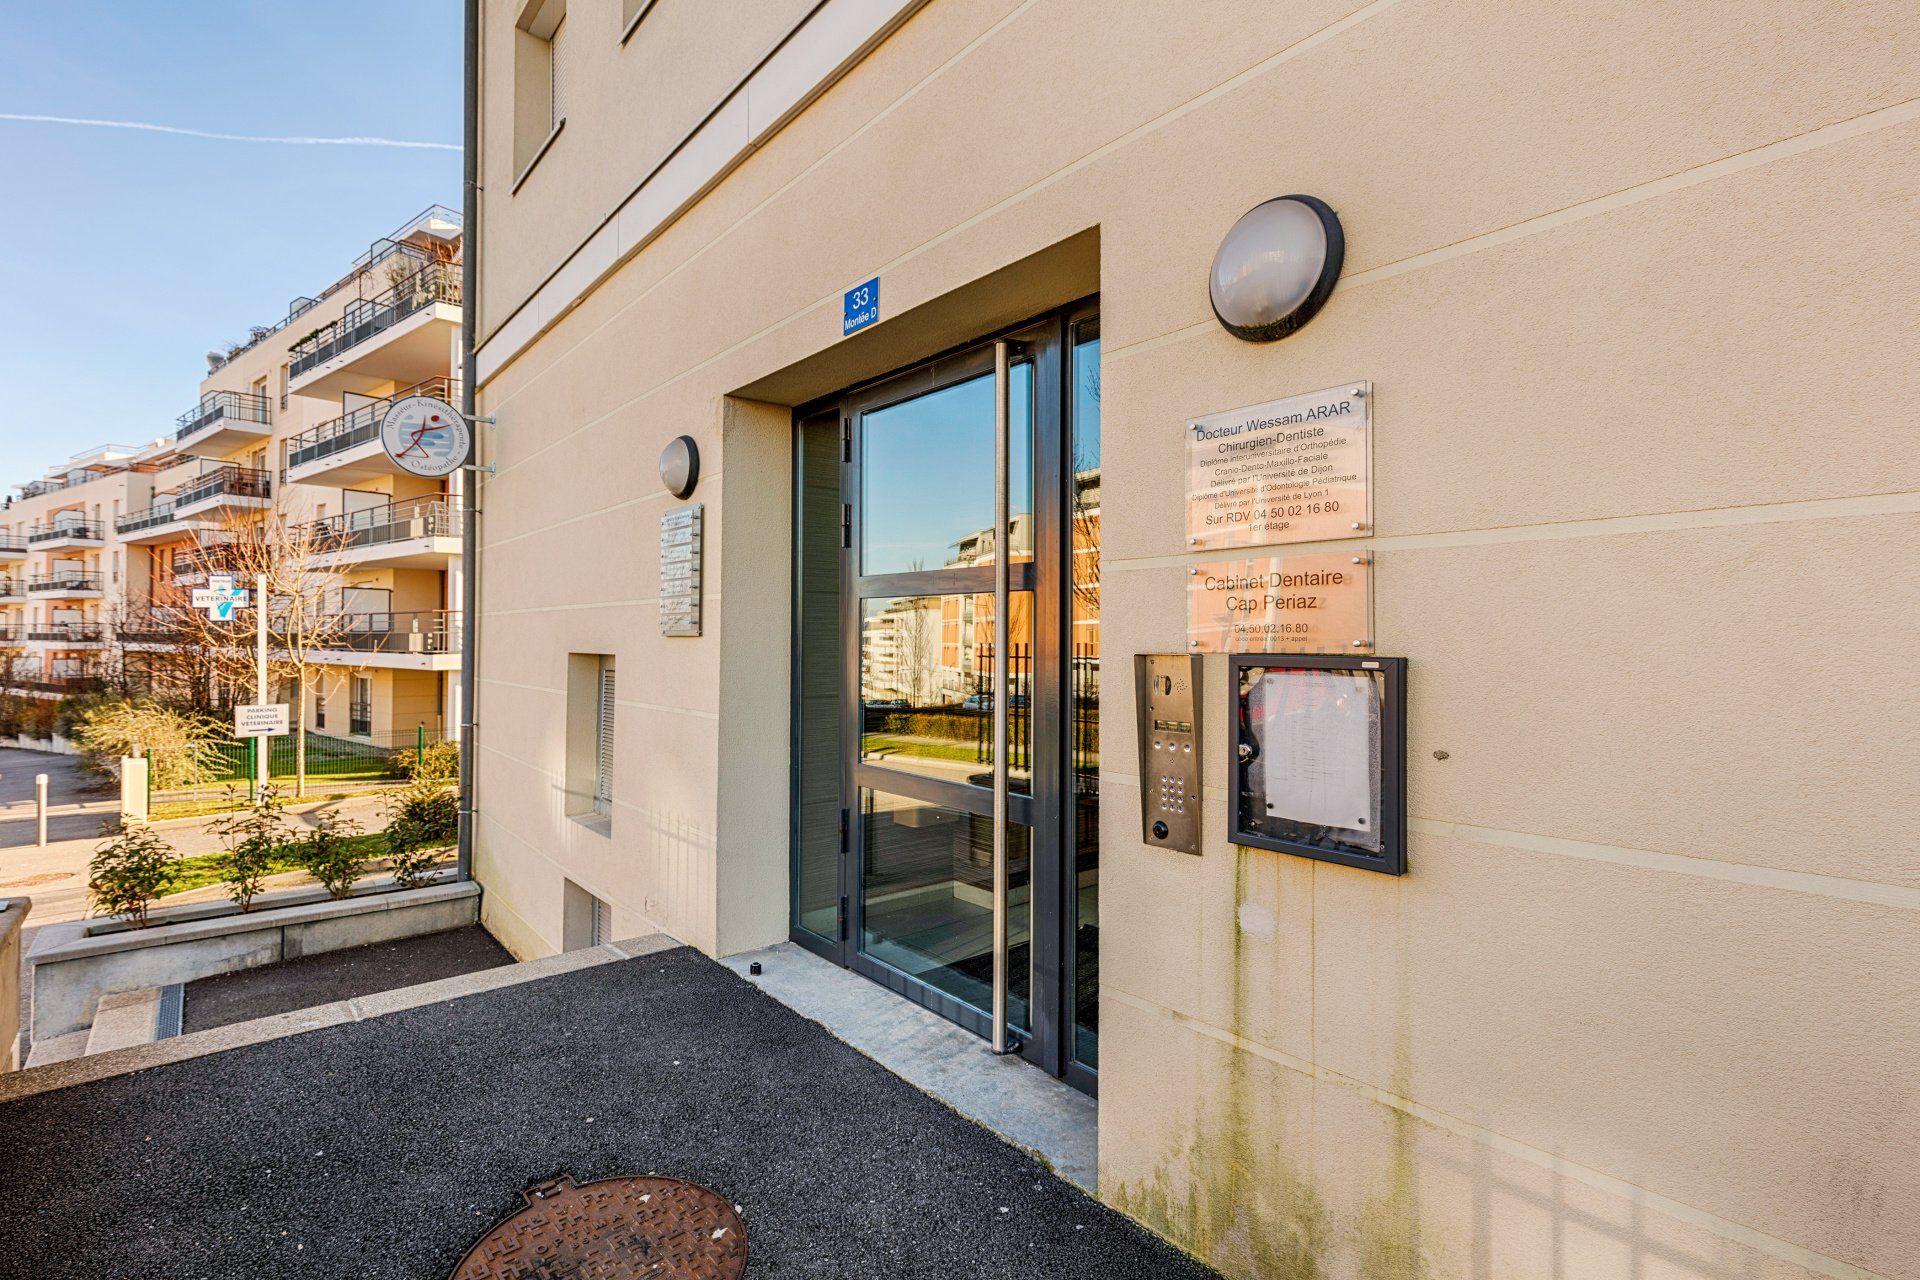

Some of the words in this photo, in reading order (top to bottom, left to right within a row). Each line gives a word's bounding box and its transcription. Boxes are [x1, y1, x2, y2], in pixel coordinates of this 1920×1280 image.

[853, 288, 869, 309] 33
[845, 311, 869, 330] Montée
[871, 307, 877, 319] D
[1196, 425, 1243, 442] Docteur
[1246, 413, 1303, 432] Wessam
[1306, 401, 1351, 421] ARAR
[1218, 427, 1324, 453] Chirurgien-Dentiste
[1200, 456, 1229, 468] Diplôme
[1231, 447, 1292, 463] interuniversitaire
[1294, 438, 1347, 452] d'Orthopédie
[1214, 453, 1329, 476] Cranio-Dento-Maxillo-Faciale
[1210, 478, 1236, 488] Délivré
[1238, 476, 1251, 485] par
[1252, 469, 1296, 482] l'Université
[1298, 468, 1309, 476] de
[1311, 465, 1334, 475] Dijon
[1312, 473, 1358, 486] Pédiatrique
[1238, 499, 1250, 509] par
[1292, 492, 1303, 500] de
[1303, 490, 1323, 500] Lyon
[1324, 488, 1329, 496] 1
[1206, 515, 1224, 526] Sur
[1226, 511, 1251, 523] RDV
[1253, 509, 1267, 520] 04
[1270, 507, 1285, 518] 50
[1287, 504, 1302, 517] 02
[1306, 502, 1321, 514] 16
[1324, 500, 1340, 513] 80
[1248, 523, 1262, 532] 1er
[1264, 521, 1290, 532] étage
[1204, 573, 1265, 591] Cabinet
[1269, 569, 1344, 588] Dentaire
[1225, 596, 1258, 614] Cap
[1263, 593, 1318, 610] Periaz
[1234, 623, 1309, 634] 04.50.02.16.80
